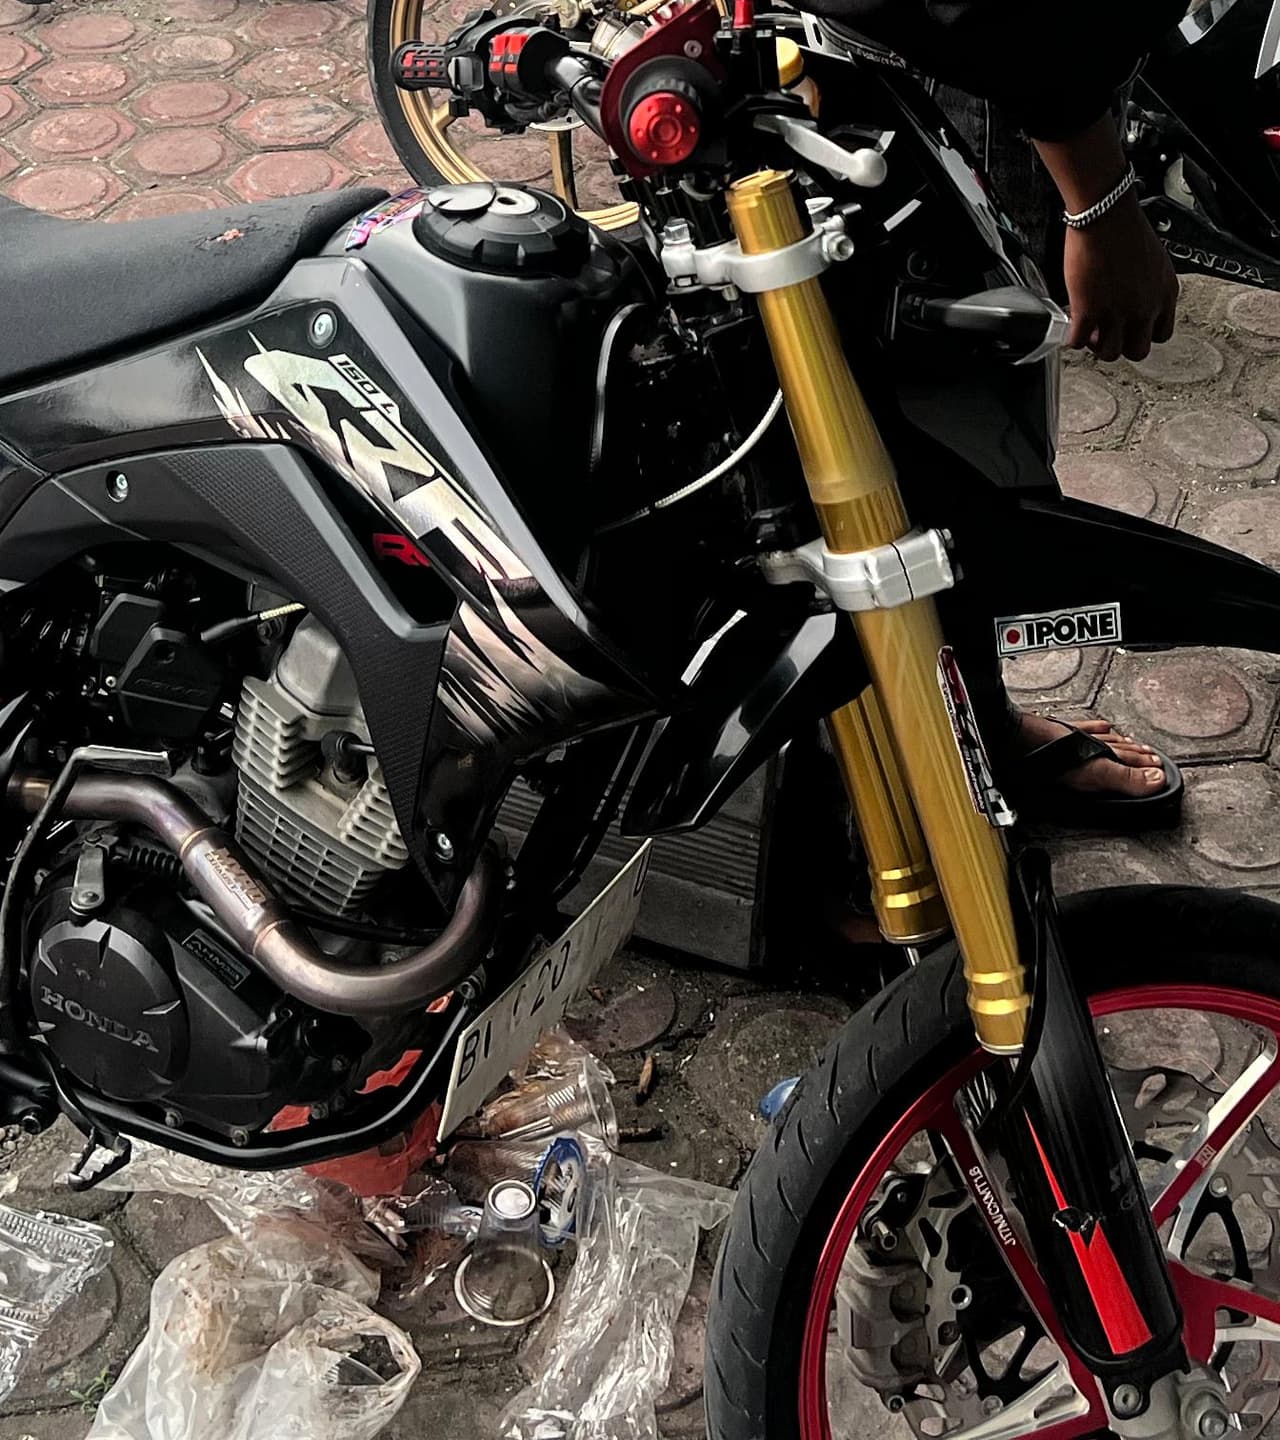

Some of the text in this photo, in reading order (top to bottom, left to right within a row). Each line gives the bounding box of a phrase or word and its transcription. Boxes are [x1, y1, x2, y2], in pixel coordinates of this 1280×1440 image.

[1160, 237, 1265, 284] ONDA
[337, 360, 381, 395] 150
[1024, 610, 1116, 648] IPONE
[40, 985, 160, 1054] HONDA
